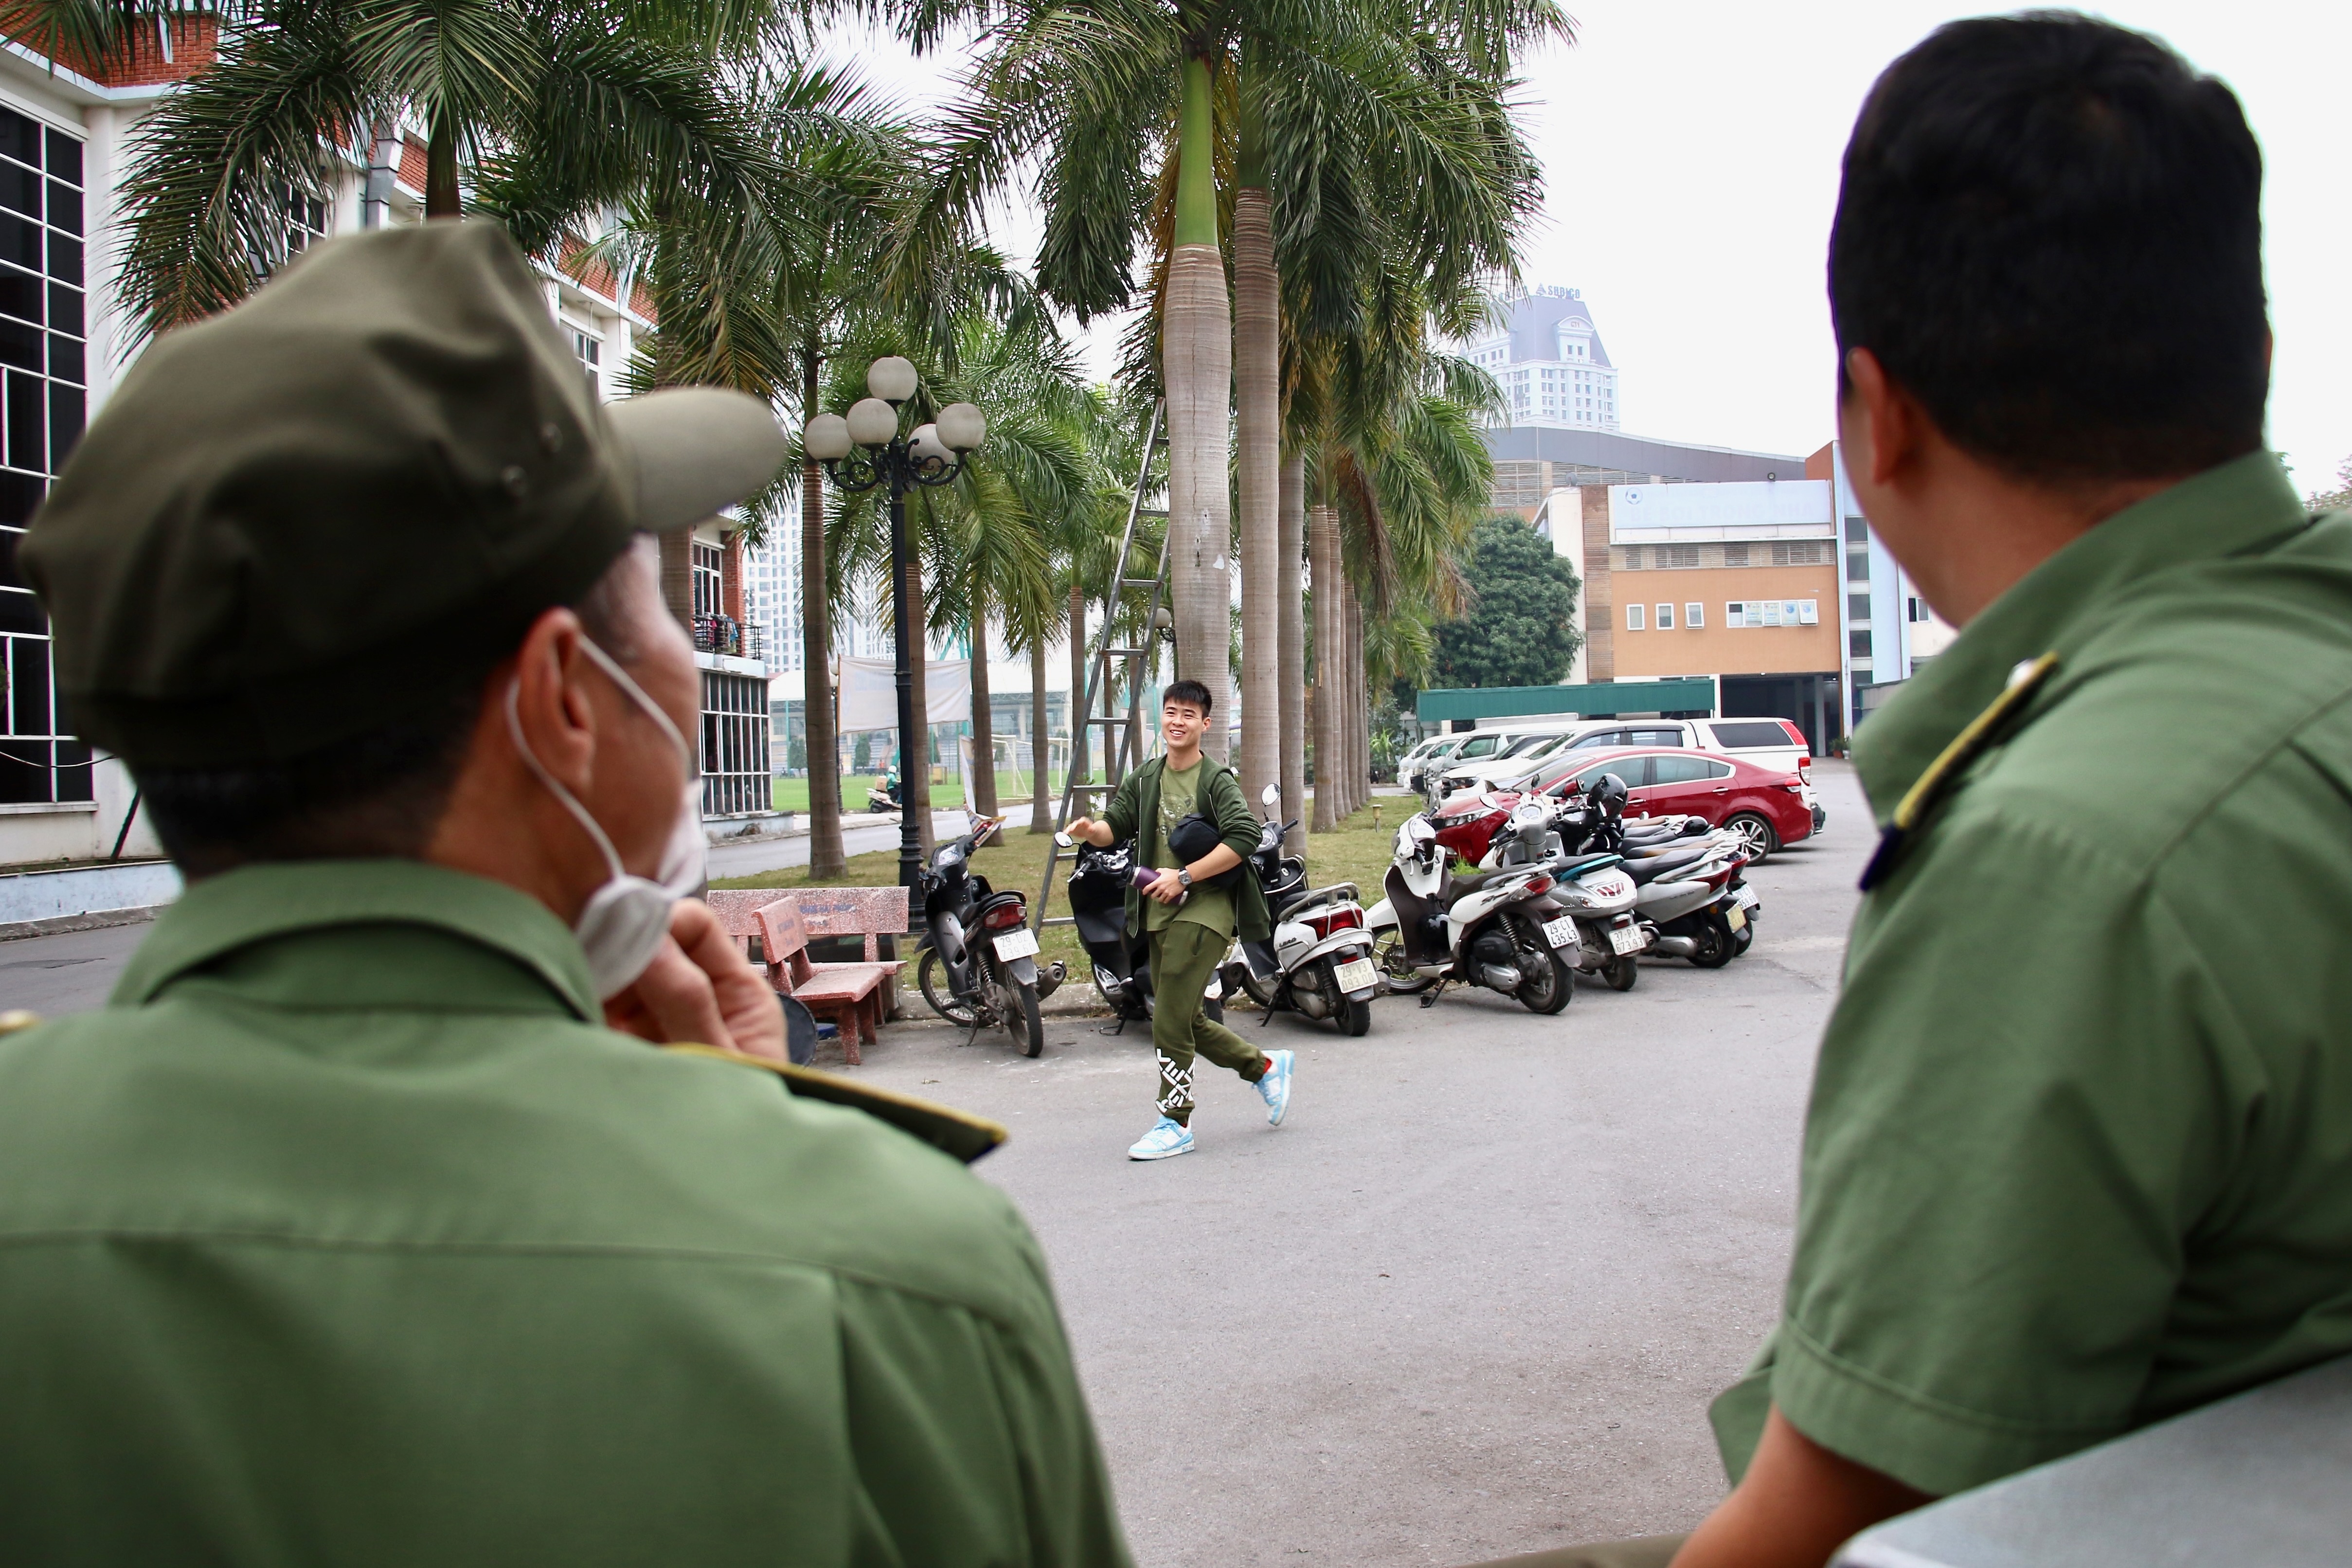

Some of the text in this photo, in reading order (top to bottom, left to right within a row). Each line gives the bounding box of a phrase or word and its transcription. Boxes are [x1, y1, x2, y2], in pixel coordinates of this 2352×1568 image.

[1548, 919, 1570, 934] 29-C1
[1000, 932, 1028, 948] 29-D2
[1551, 929, 1578, 946] 435.43
[1614, 928, 1636, 942] 37-P1
